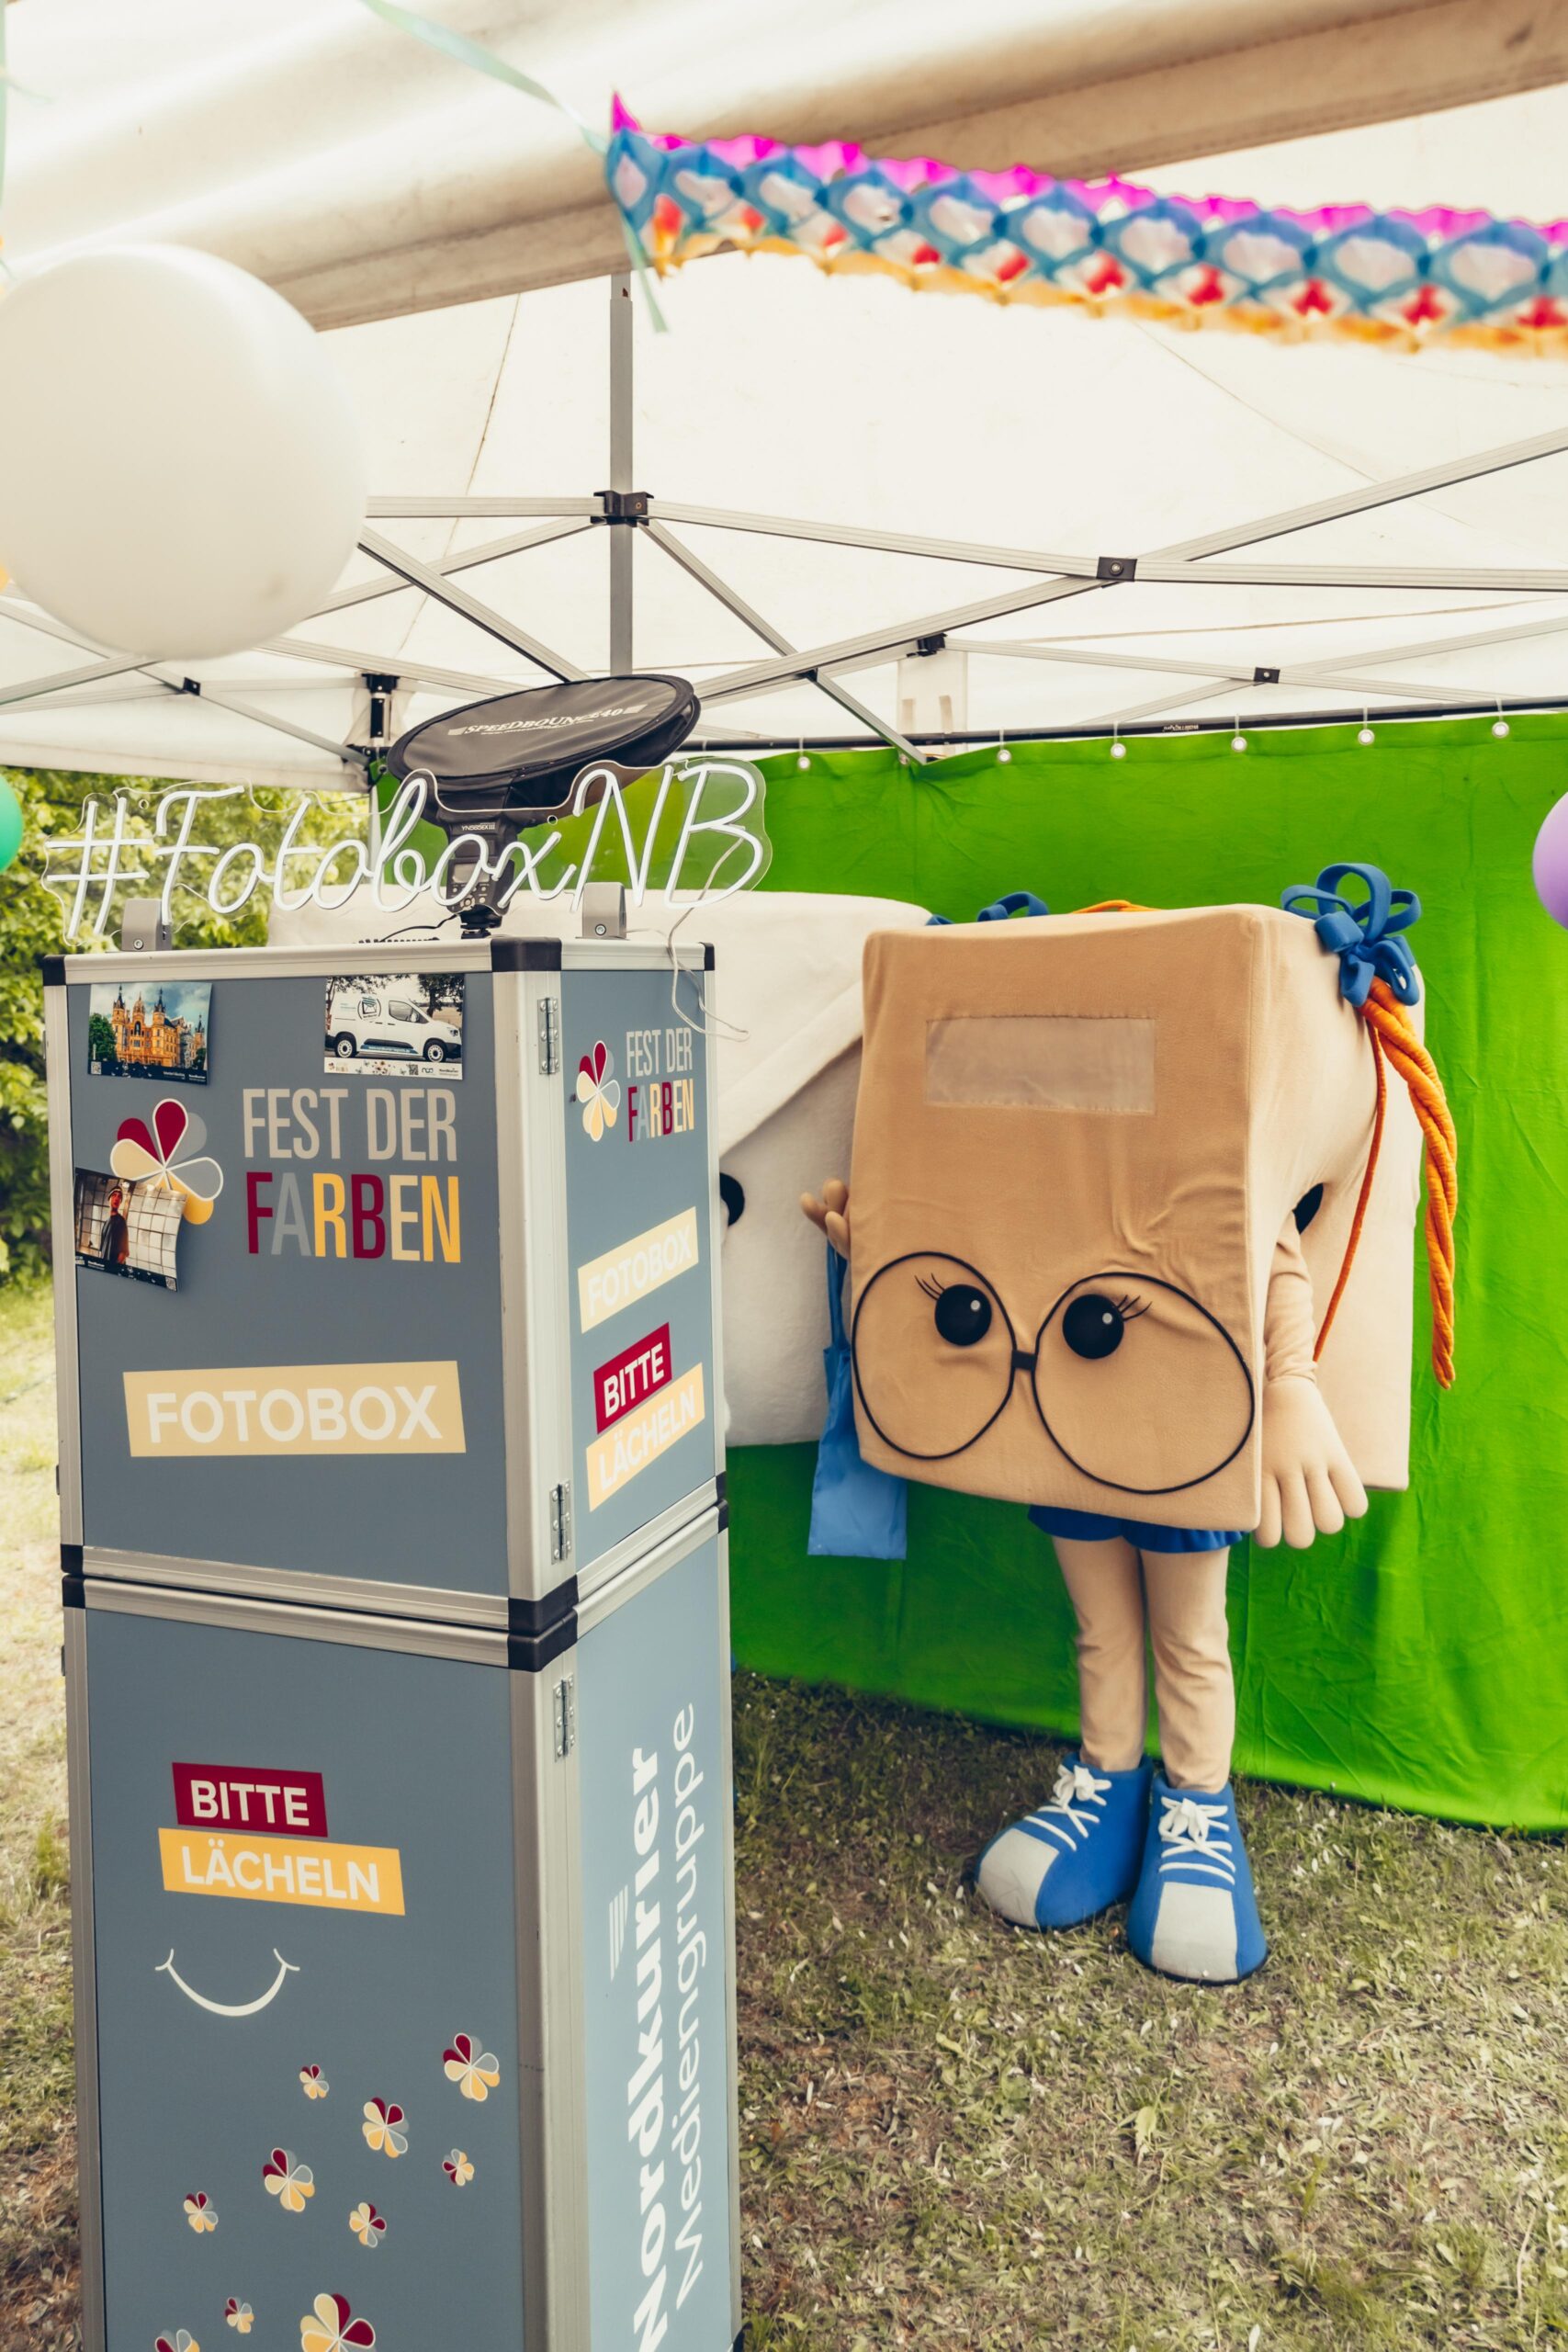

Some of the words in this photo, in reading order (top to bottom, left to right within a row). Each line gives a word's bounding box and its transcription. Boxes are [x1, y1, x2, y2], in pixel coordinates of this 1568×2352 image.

[46, 763, 763, 939] #FotoboxNB
[626, 1029, 661, 1079] FEST
[665, 1027, 693, 1073] DER
[243, 1088, 349, 1160] FEST
[367, 1088, 457, 1161] DER
[627, 1078, 694, 1142] FARBEN
[246, 1171, 461, 1263] FARBEN
[588, 1225, 692, 1317] FOTOBOX
[146, 1385, 443, 1444] FOTOBOX
[603, 1342, 665, 1419] BITTE
[599, 1385, 695, 1491] LÄCHELN
[190, 1779, 310, 1826] BITTE
[181, 1838, 380, 1903] LÄCHELN
[671, 1702, 706, 2311] Mediengruppe
[627, 1747, 669, 2352] Nordkurier
